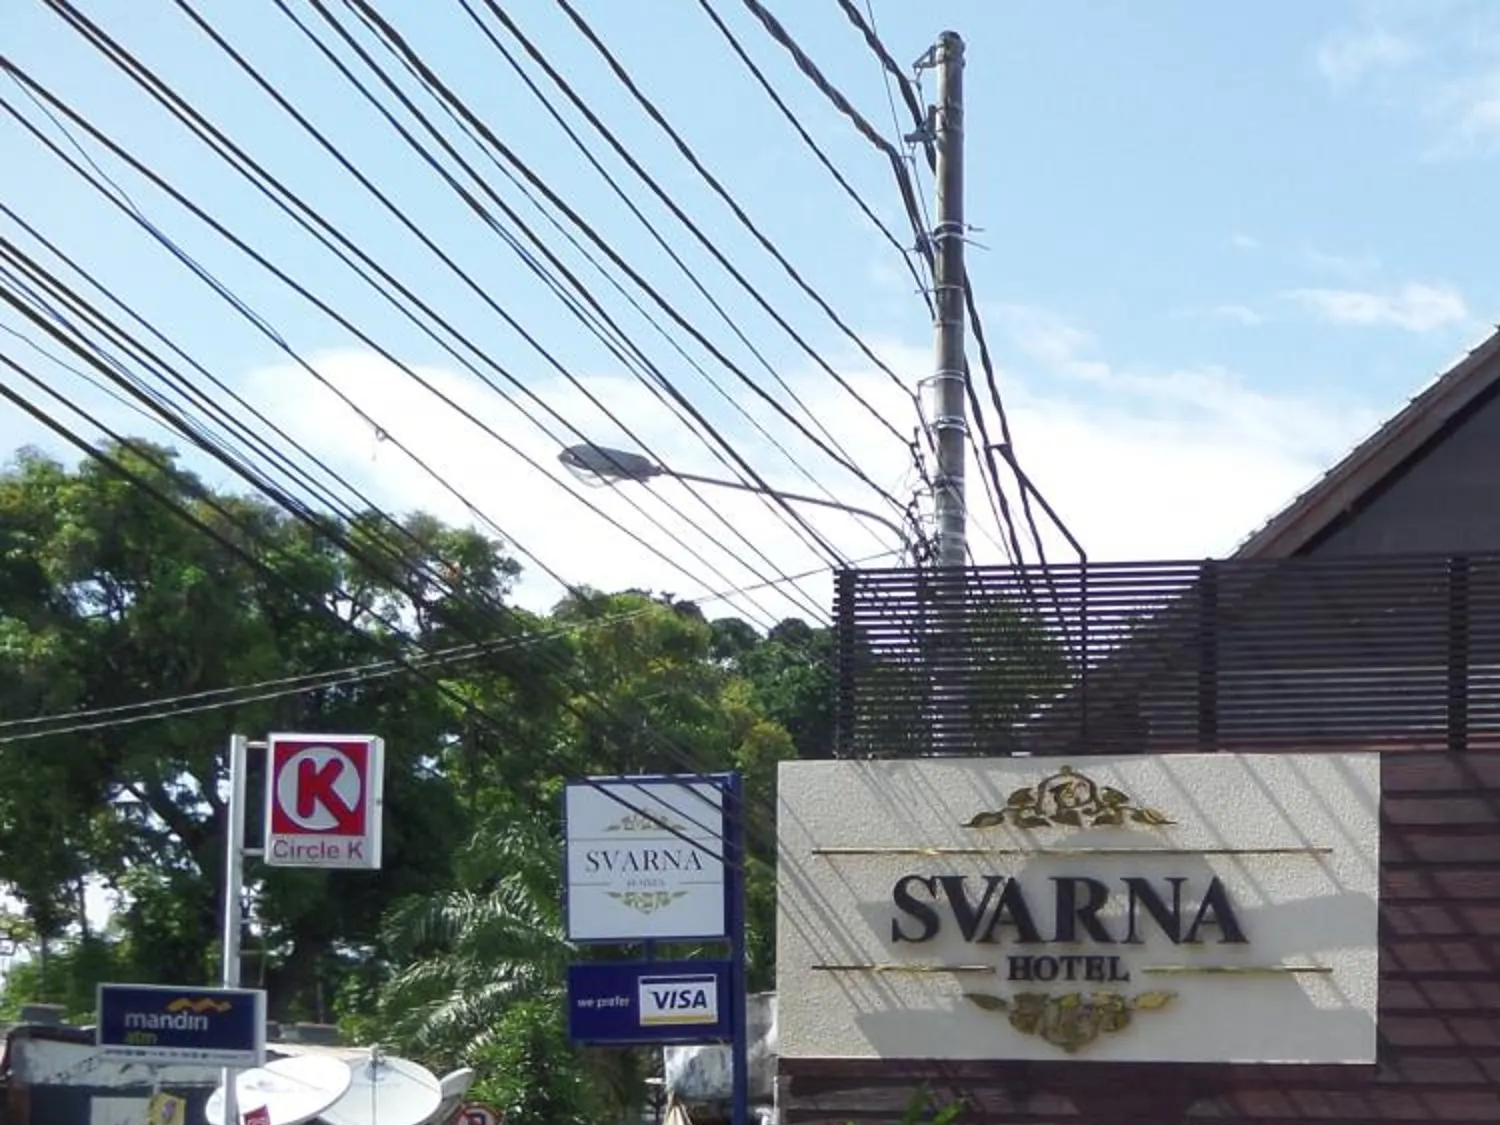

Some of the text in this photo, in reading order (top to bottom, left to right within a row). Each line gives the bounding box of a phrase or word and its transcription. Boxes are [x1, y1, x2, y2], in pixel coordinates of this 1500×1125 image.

[272, 839, 364, 860] Circle K
[585, 849, 705, 873] SVARNA
[891, 874, 1249, 945] SVARNA
[1008, 955, 1130, 983] HOTEL
[650, 989, 708, 1010] VISA
